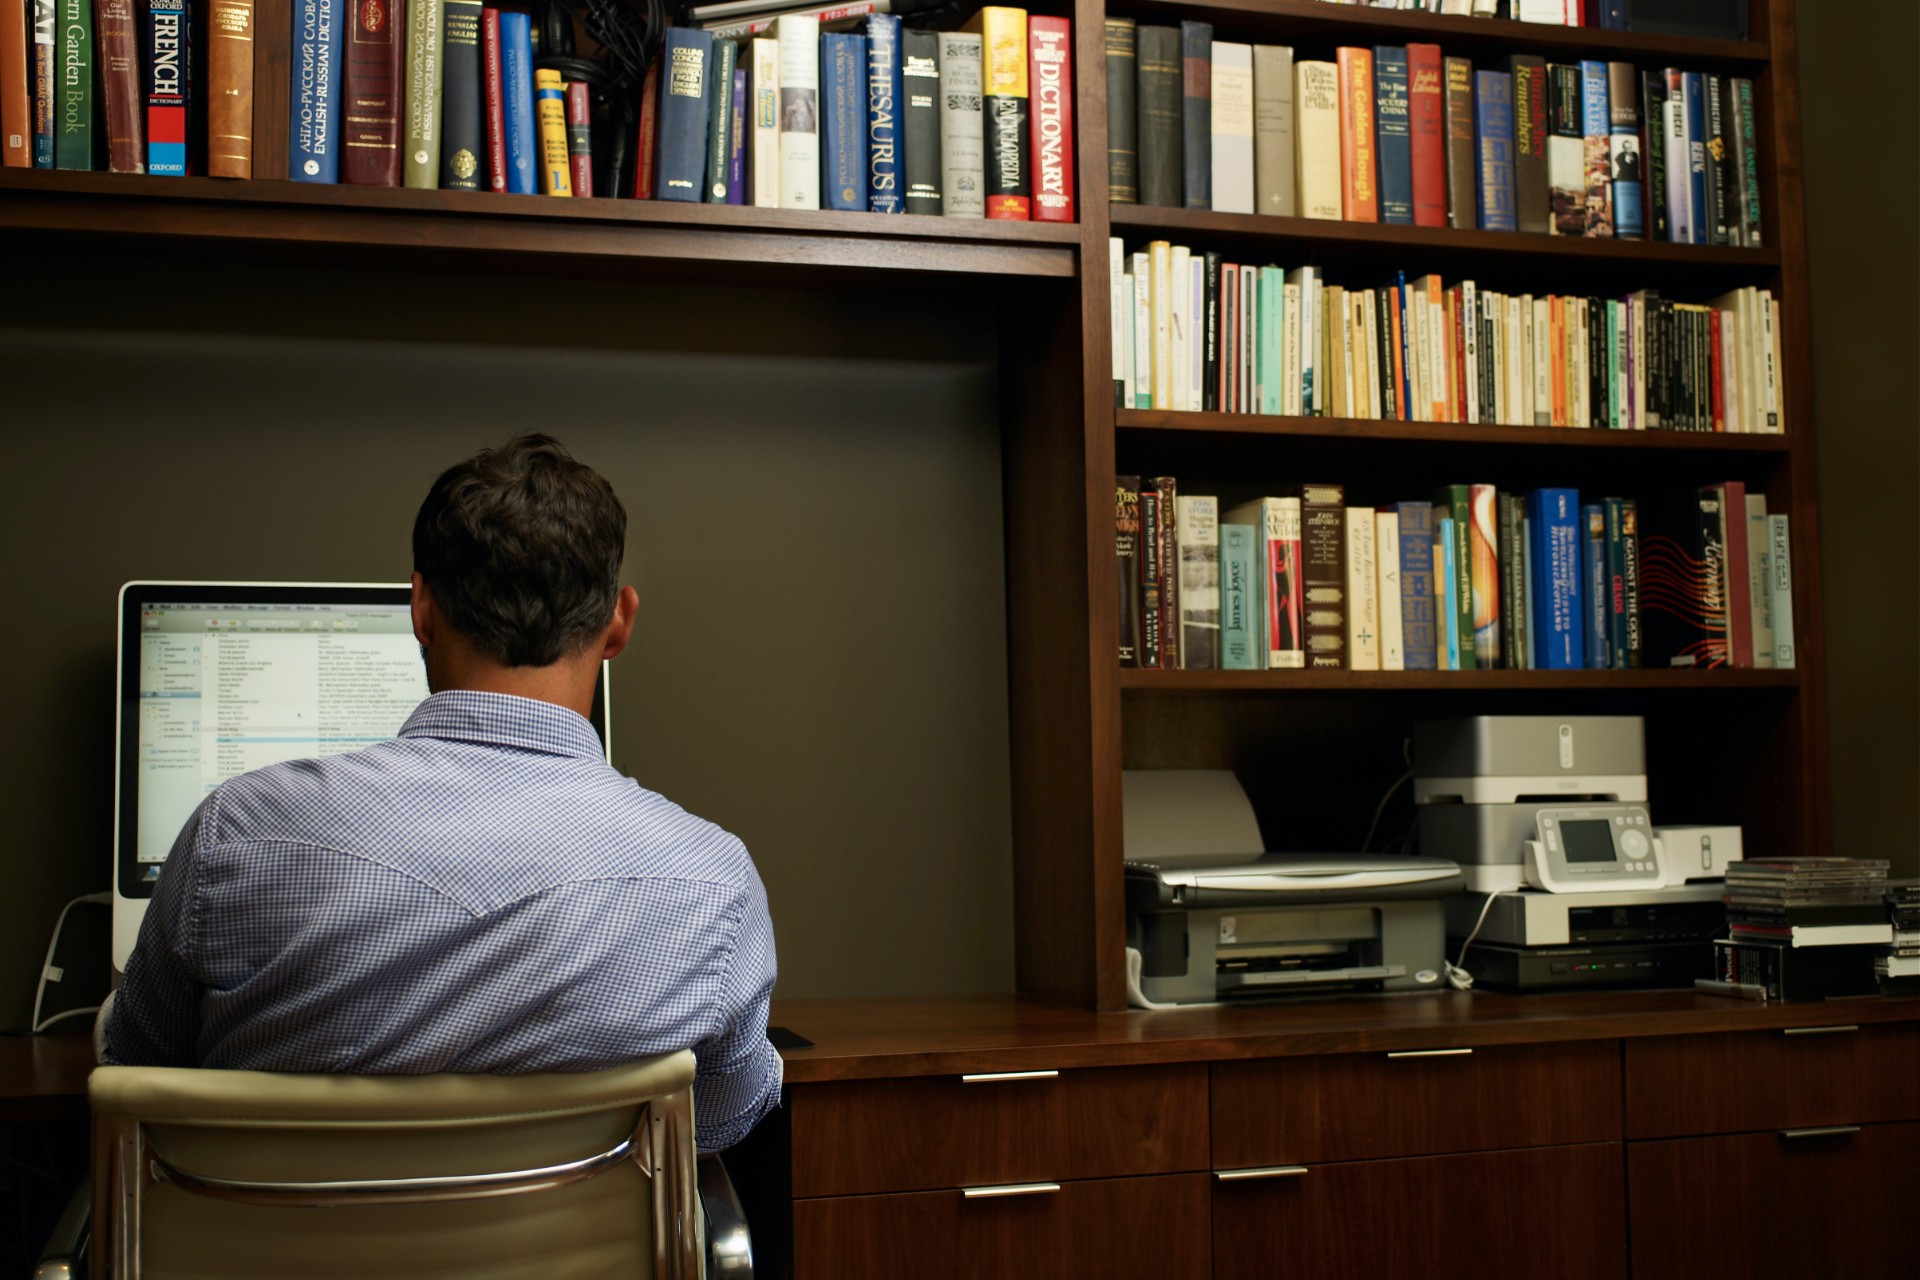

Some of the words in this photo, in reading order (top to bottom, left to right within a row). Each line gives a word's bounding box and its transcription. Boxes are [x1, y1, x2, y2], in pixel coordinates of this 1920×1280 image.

[67, 25, 86, 86] Garden
[154, 14, 179, 94] FRENCH
[672, 47, 704, 57] COLLINS
[721, 46, 729, 81] DICTIONARY
[412, 33, 425, 139] РУССКО-АНГЛИЙСКИЙ
[1353, 57, 1367, 87] The
[1379, 82, 1392, 90] The
[1393, 82, 1407, 91] Rise
[1412, 80, 1441, 94] Literature
[1415, 69, 1438, 82] English
[66, 91, 86, 134] Book
[300, 44, 314, 153] АНГЛО-РУССКИЙ
[314, 45, 329, 155] ENGLISH-RUSSIAN
[423, 55, 434, 141] RUSSIAN-ENGLISH
[719, 82, 728, 132] RUSSIAN-ENGLISH
[1381, 106, 1408, 115] CHINA
[1516, 65, 1532, 155] Remembers
[1531, 67, 1546, 159] Khrushchev
[1709, 76, 1721, 136] RESURRECTION
[37, 100, 45, 134] Questions
[868, 44, 896, 190] THESAURUS
[1039, 65, 1064, 195] DICTIONARY
[1355, 90, 1369, 145] Golden
[1001, 99, 1020, 188] ENCYCLOPEDIA
[150, 163, 182, 171] OXFORD
[553, 171, 568, 191] L
[1357, 149, 1371, 201] Bough
[1147, 518, 1154, 526] to
[1147, 527, 1155, 545] Read
[1267, 514, 1301, 526] Oscar
[1267, 525, 1301, 537] Wilde
[1308, 518, 1340, 526] STEINBECK
[1147, 548, 1155, 562] and
[1165, 528, 1173, 575] COLLECTED
[1353, 528, 1361, 575] READER
[1551, 525, 1559, 578] HISTORIC
[1625, 537, 1637, 587] AGAINST
[1147, 564, 1157, 580] Why
[1166, 577, 1174, 602] POEMS
[1228, 561, 1245, 592] Joyce
[1229, 593, 1243, 632] James
[1364, 598, 1373, 624] Singer
[1553, 577, 1562, 632] SCOTLAND
[1613, 574, 1623, 614] CHAOS
[1628, 590, 1638, 614] THE
[1561, 617, 1570, 630] TO
[1629, 617, 1639, 650] GODS
